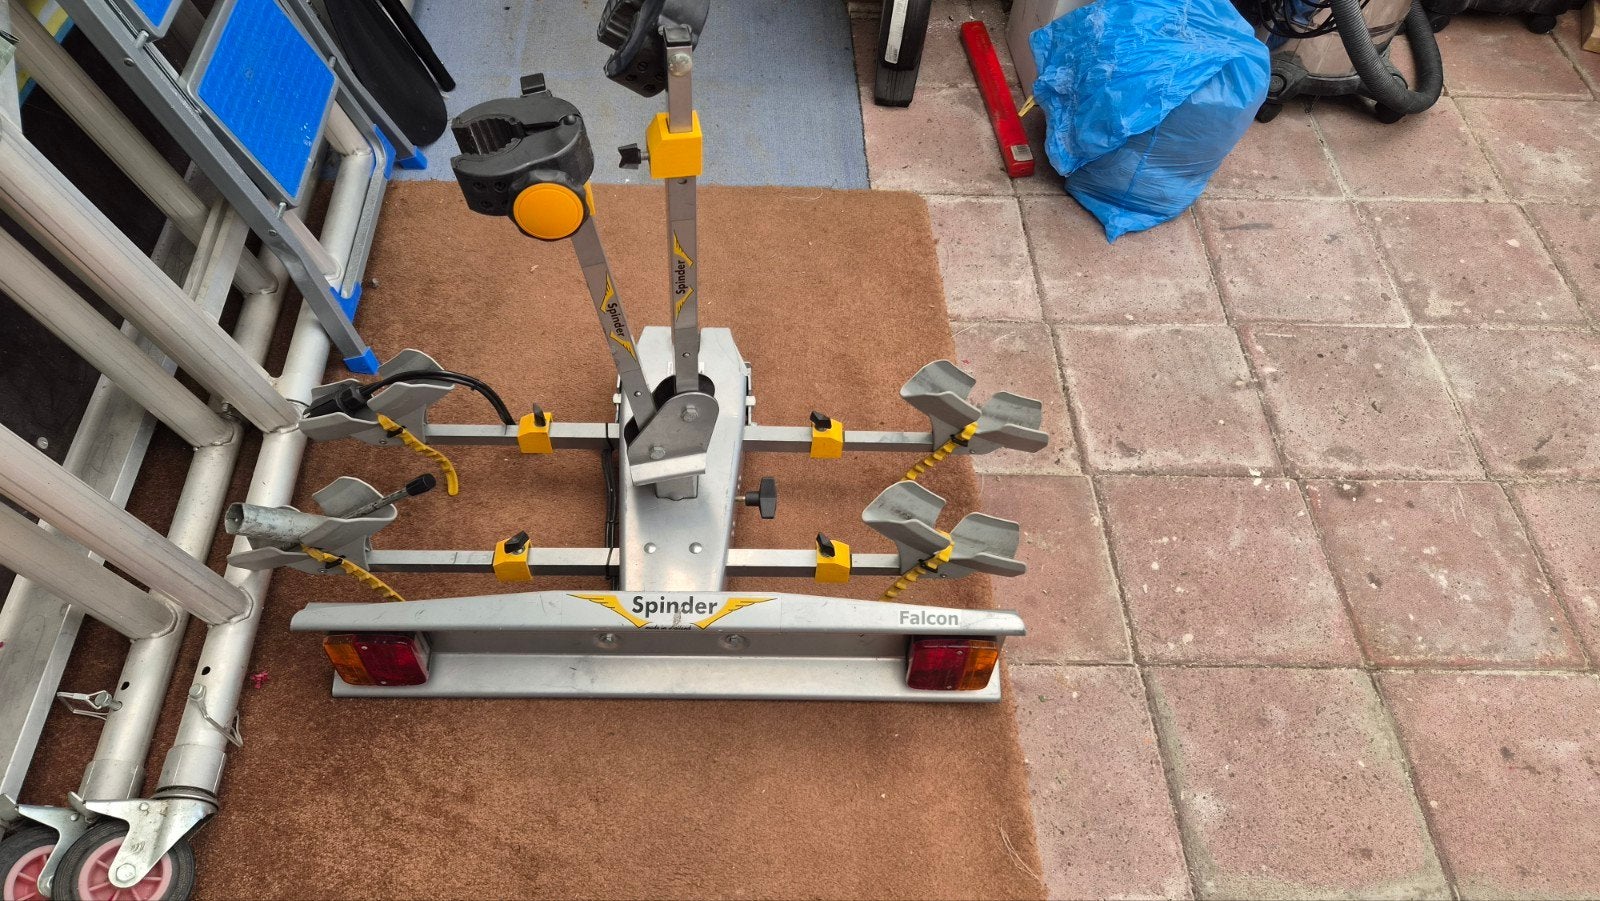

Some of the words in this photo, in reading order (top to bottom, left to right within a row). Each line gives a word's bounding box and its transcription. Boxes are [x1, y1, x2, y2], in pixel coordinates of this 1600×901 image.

[675, 260, 688, 295] Spinder
[607, 302, 625, 337] Spinder
[632, 595, 718, 618] Spinder
[900, 610, 959, 626] Falcon
